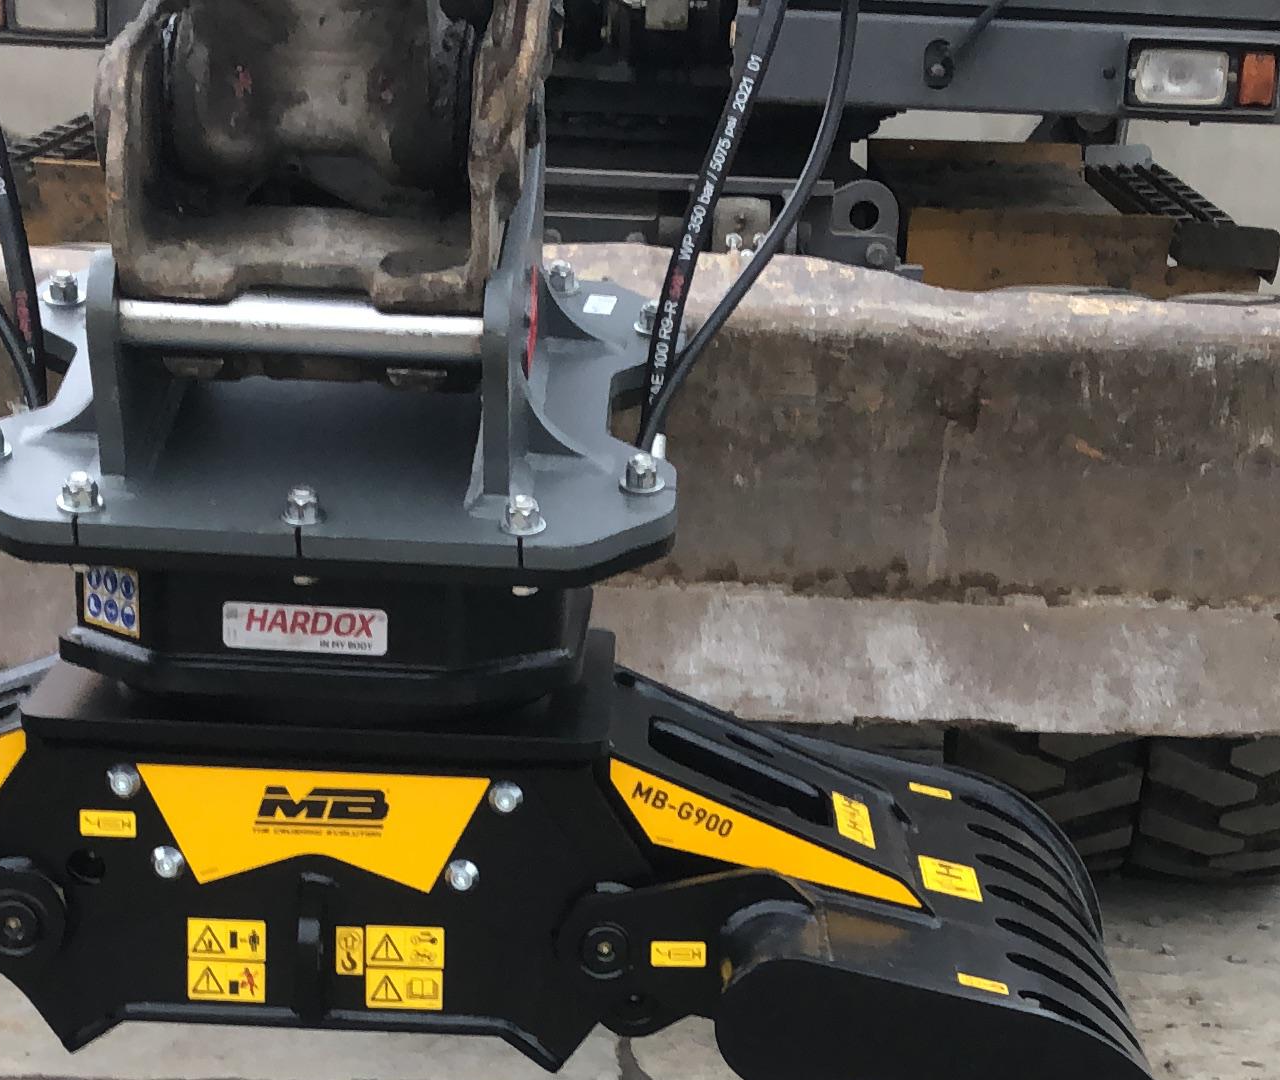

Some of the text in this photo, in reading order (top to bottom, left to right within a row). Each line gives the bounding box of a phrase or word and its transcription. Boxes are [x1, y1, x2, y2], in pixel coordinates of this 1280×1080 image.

[678, 233, 696, 261] WP
[687, 204, 707, 233] 350
[698, 179, 715, 205] bar
[709, 137, 732, 172] 5075
[724, 115, 738, 138] psi
[732, 76, 755, 113] 2021
[747, 54, 763, 72] 01
[654, 341, 670, 368] 100
[245, 608, 376, 638] HARDOX
[258, 785, 390, 820] MB
[631, 781, 733, 837] MB-G900
